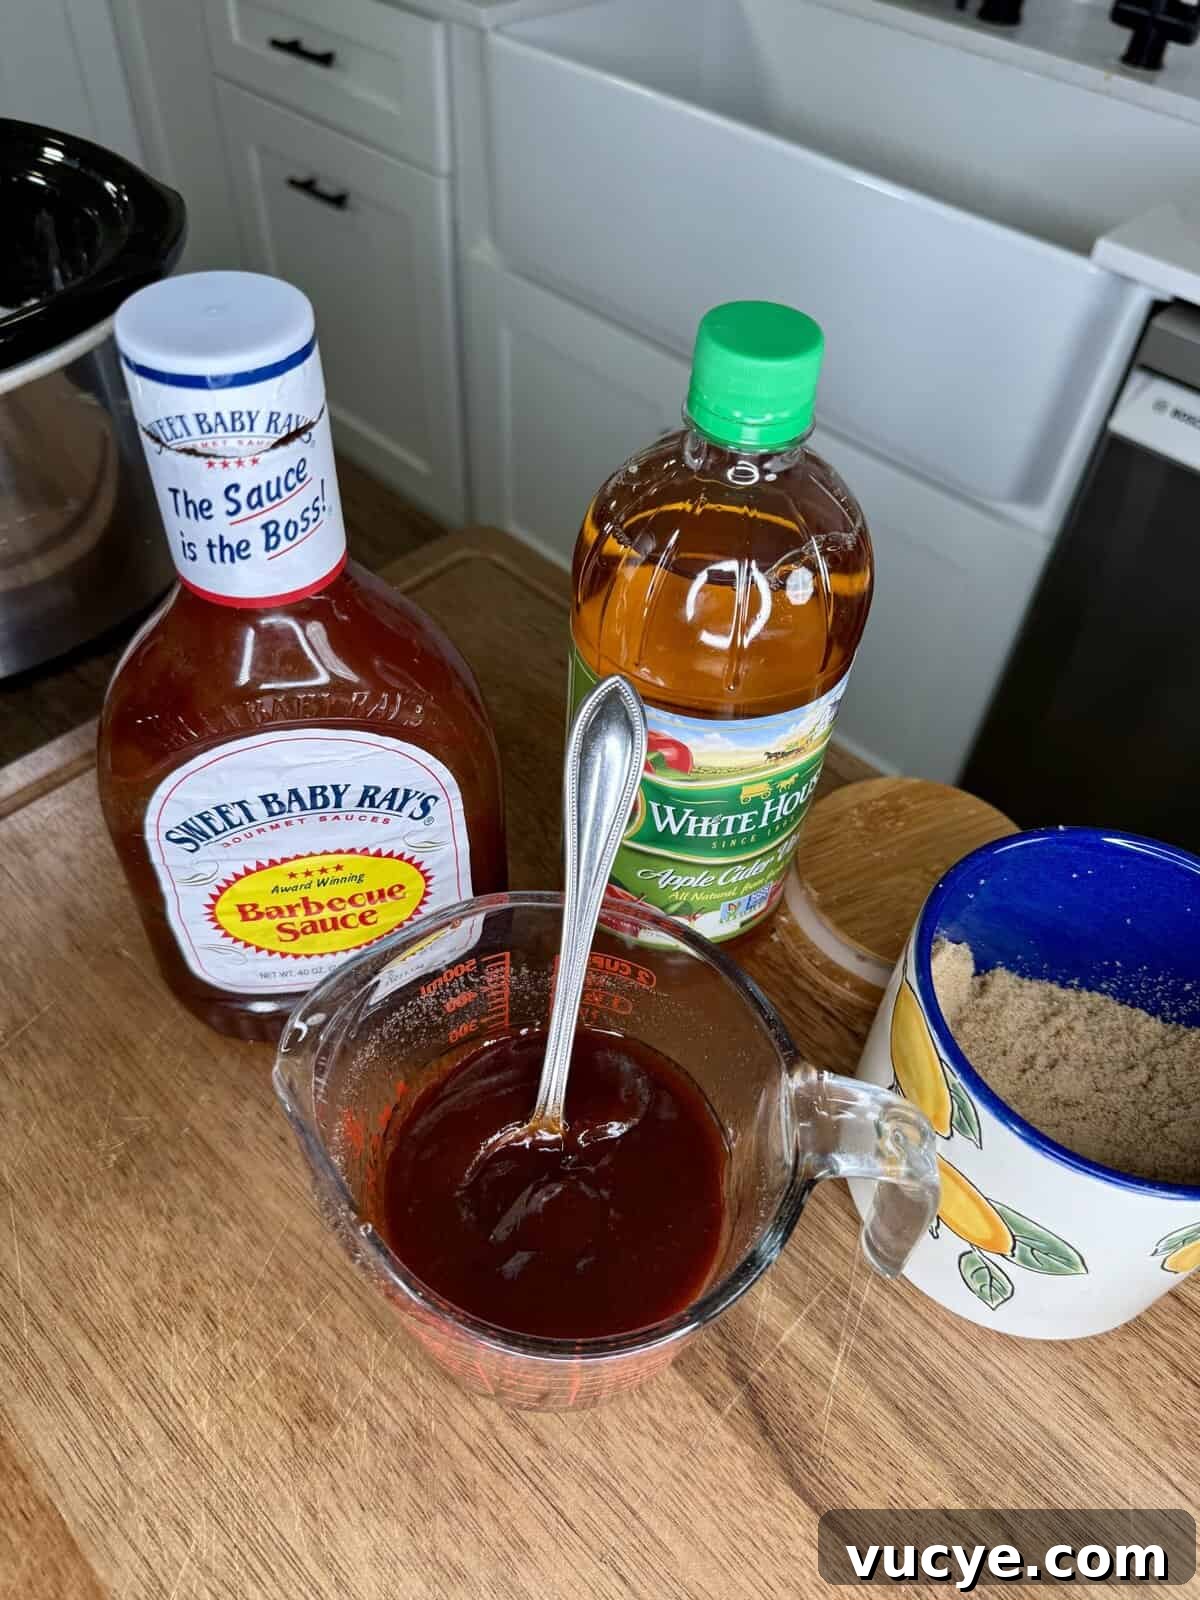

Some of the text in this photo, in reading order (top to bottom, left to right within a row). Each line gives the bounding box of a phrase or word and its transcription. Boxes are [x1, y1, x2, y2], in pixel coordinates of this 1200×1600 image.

[193, 410, 261, 434] BABY
[168, 457, 308, 522] The Sauce
[180, 479, 327, 564] is the Boss!
[165, 784, 440, 854] SWEET BABY RAY'S
[221, 814, 392, 849] GOURMET SAUCES
[711, 834, 756, 850] SINCE
[271, 872, 366, 894] Award Winning
[637, 867, 716, 891] Apple
[718, 856, 774, 886] Cider
[236, 883, 408, 922] Barbecue
[274, 909, 379, 942] Sauce
